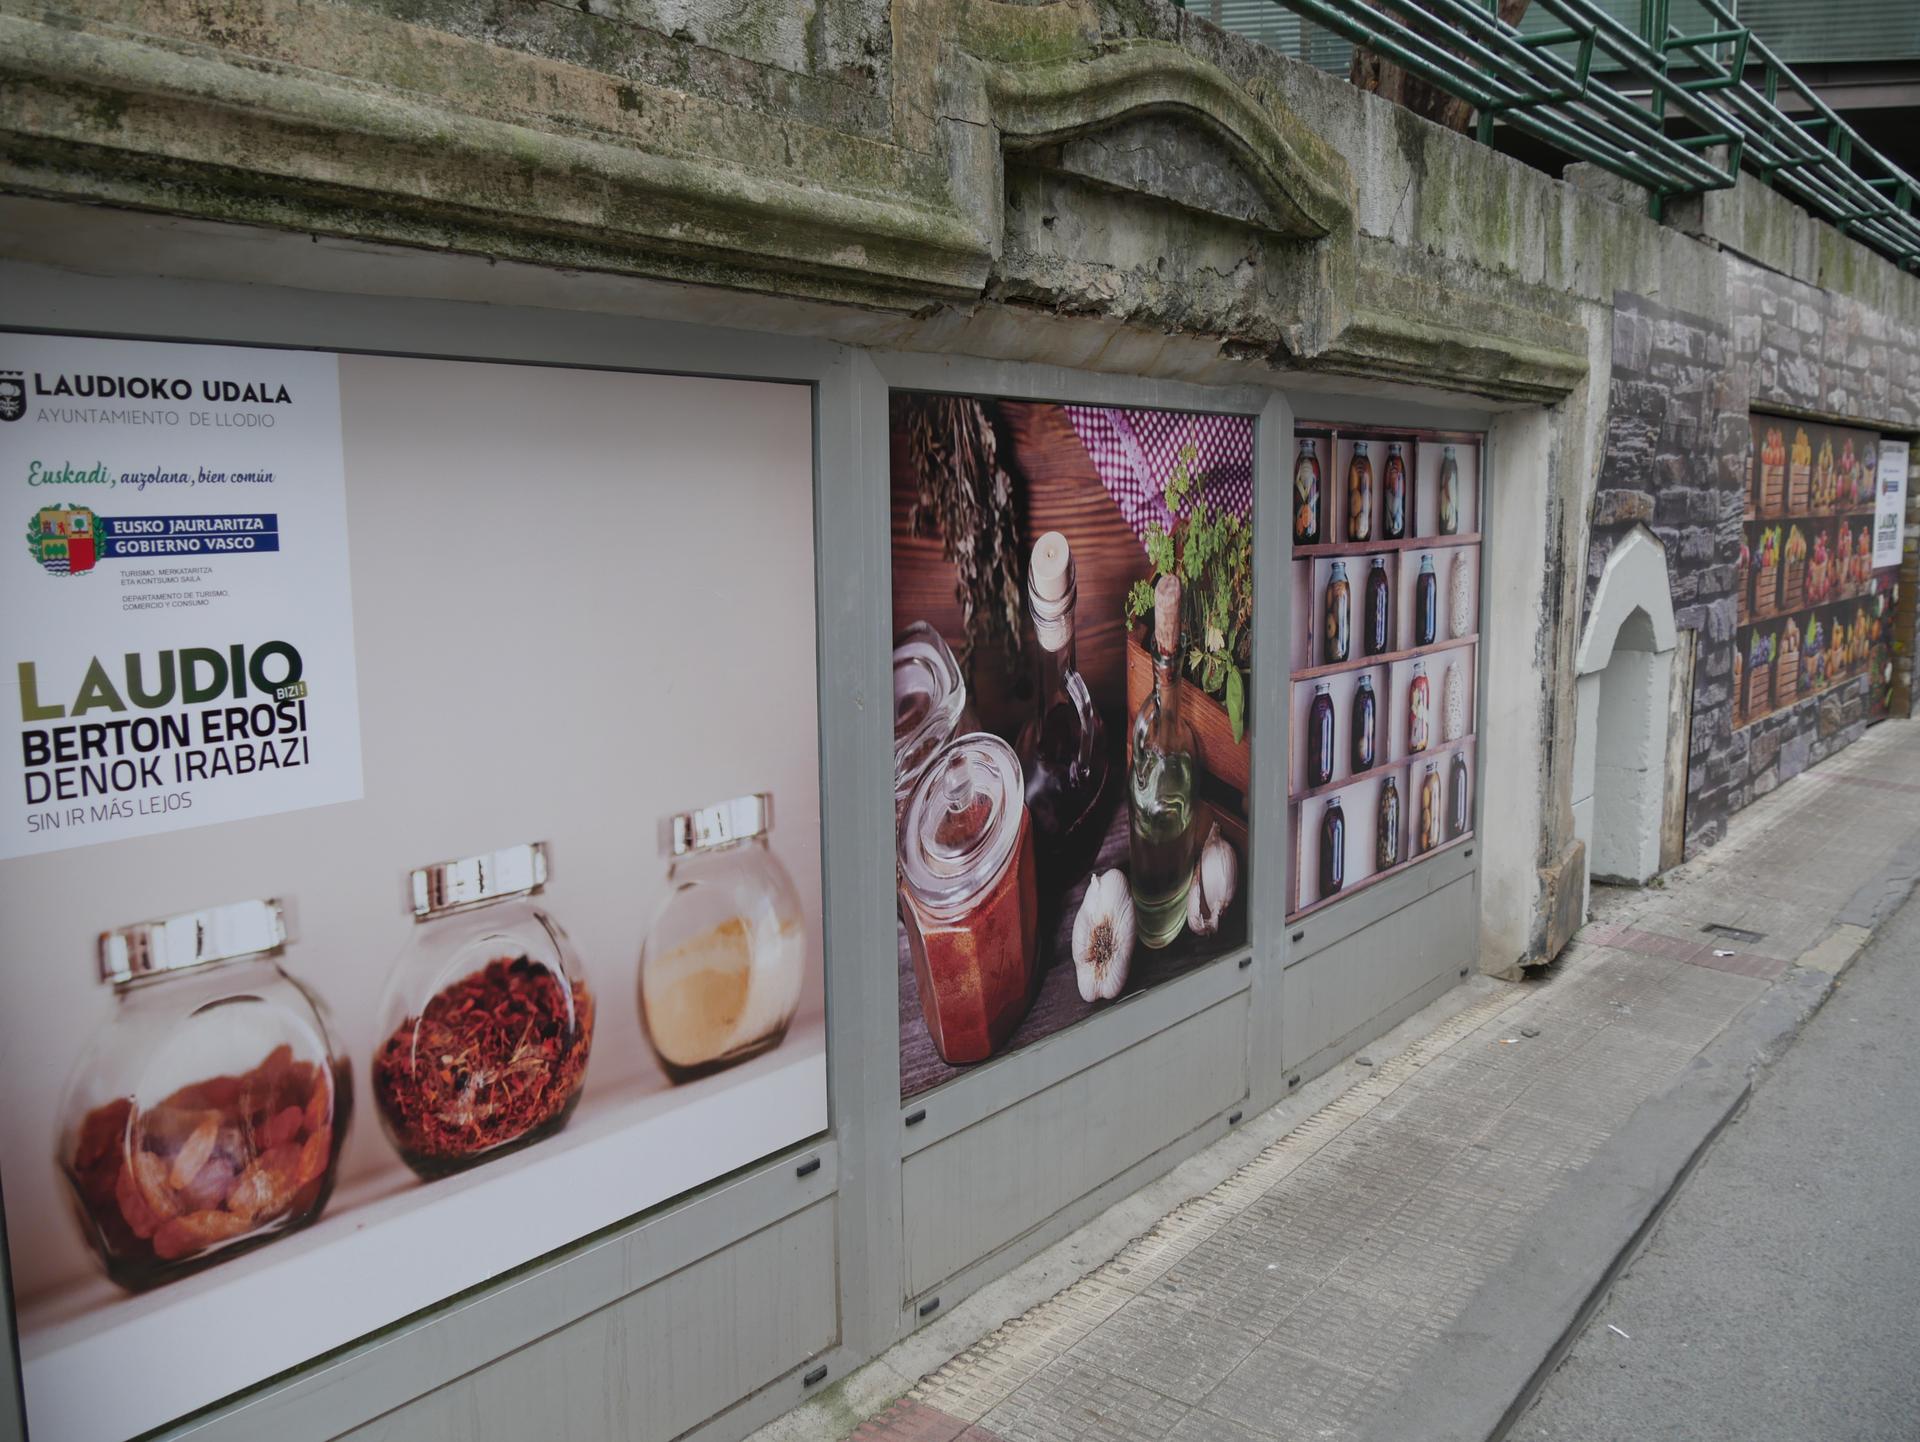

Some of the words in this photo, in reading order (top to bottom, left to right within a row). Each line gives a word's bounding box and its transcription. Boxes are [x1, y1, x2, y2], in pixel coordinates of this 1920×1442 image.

[34, 373, 192, 400] LAUDIOKO
[202, 380, 293, 404] UDALA
[37, 408, 180, 426] AYUNTAMIENTO
[190, 412, 210, 427] DE
[215, 413, 276, 428] LLODIO
[28, 460, 117, 488] Euskadi,
[120, 466, 196, 491] auzolana,
[198, 466, 226, 484] bien
[230, 469, 276, 484] común
[113, 520, 164, 534] EUSKO
[169, 517, 264, 534] JAURLARITZA
[115, 538, 200, 554] GOBIERNO
[205, 536, 255, 550] VASCO
[136, 576, 179, 585] KONTSUMO
[158, 567, 212, 575] MERKATARITZA
[122, 593, 182, 602] DEPARTAMENTO
[122, 602, 164, 610] COMERCIO
[171, 599, 209, 607] CONSUMO
[17, 640, 304, 722] LAUDIO
[22, 713, 191, 767] BERTON
[201, 699, 308, 744] EROSI
[25, 755, 164, 805] DENOK
[175, 736, 310, 783] IRABAZI
[27, 811, 60, 833] SIN
[66, 807, 85, 826] IR
[90, 798, 134, 823] MÁS
[139, 791, 193, 815] LEJOS
